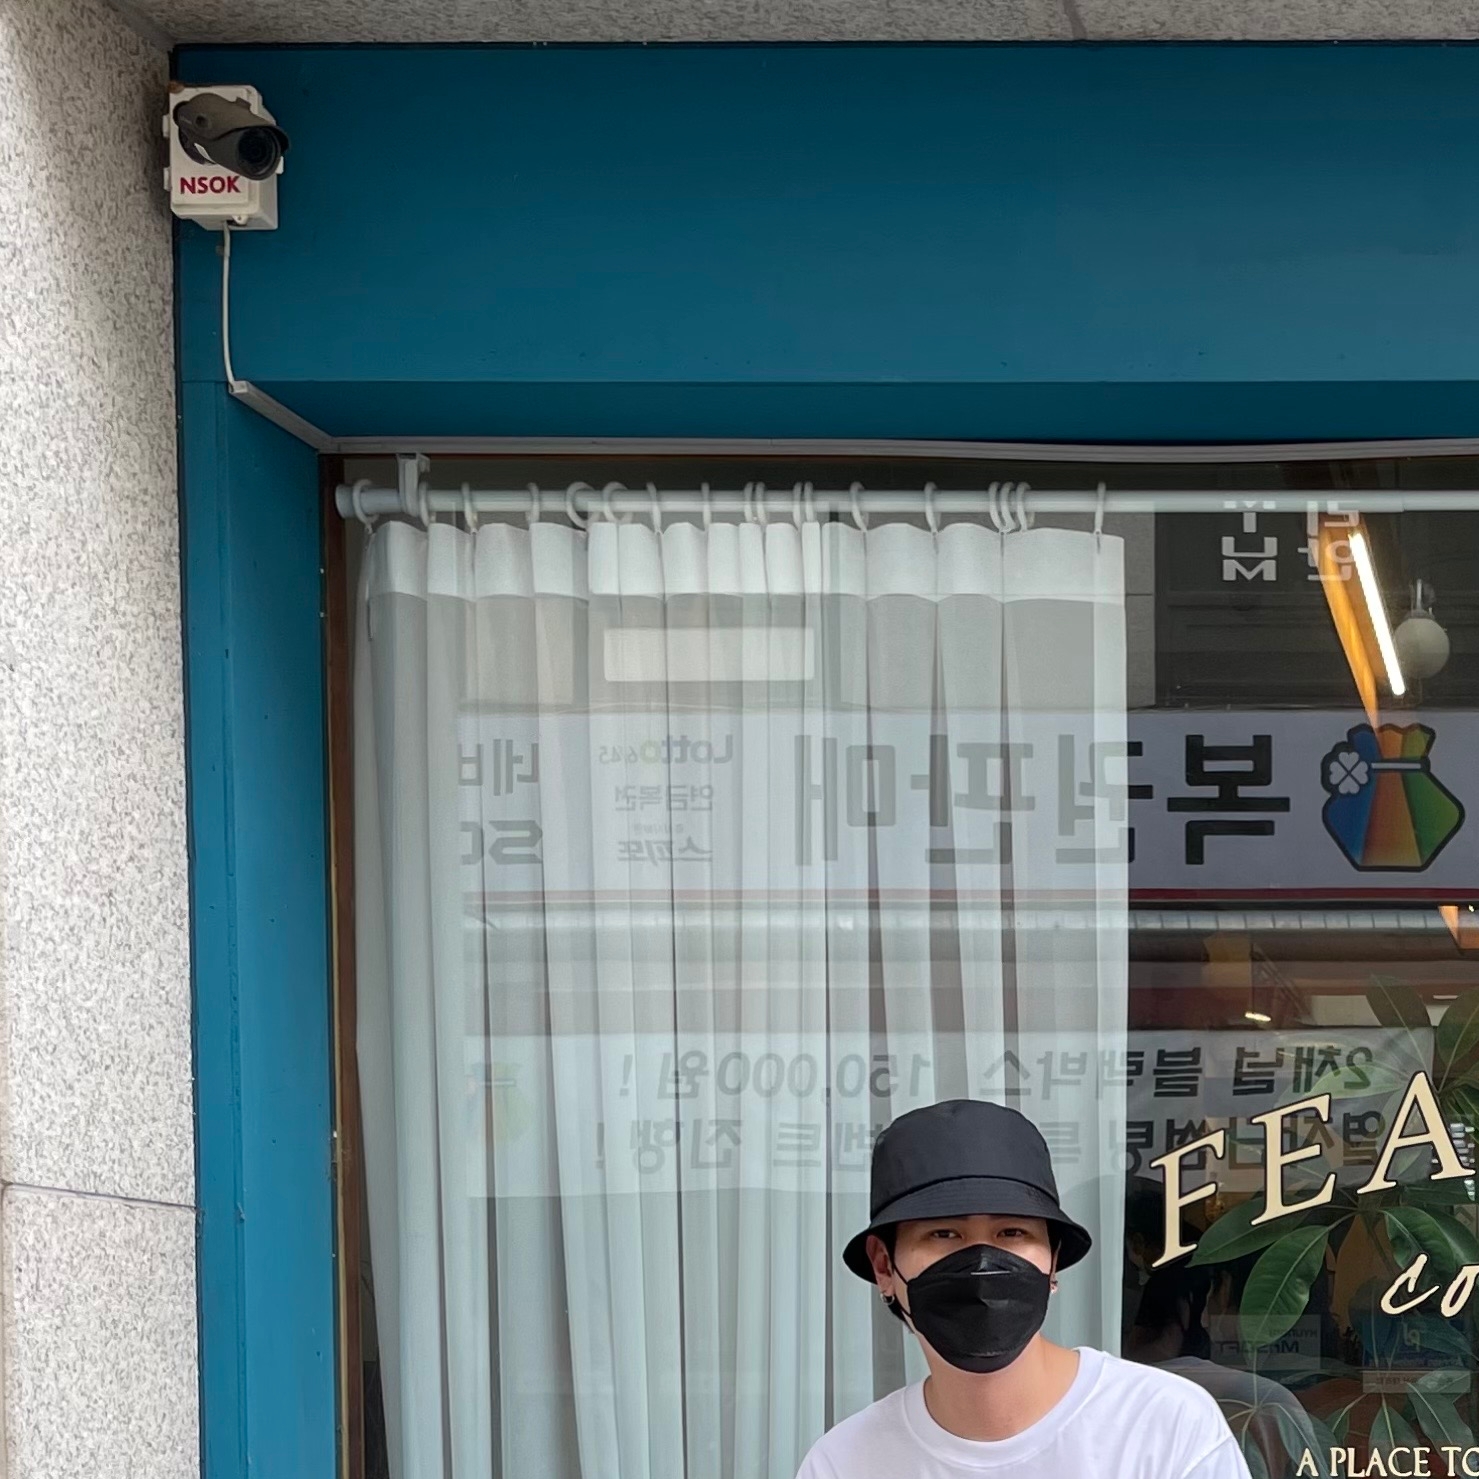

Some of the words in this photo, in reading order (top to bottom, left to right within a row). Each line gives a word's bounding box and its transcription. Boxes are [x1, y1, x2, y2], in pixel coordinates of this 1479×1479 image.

[180, 175, 241, 195] NSOK
[1295, 1446, 1319, 1478] A
[1329, 1446, 1432, 1478] PLACE
